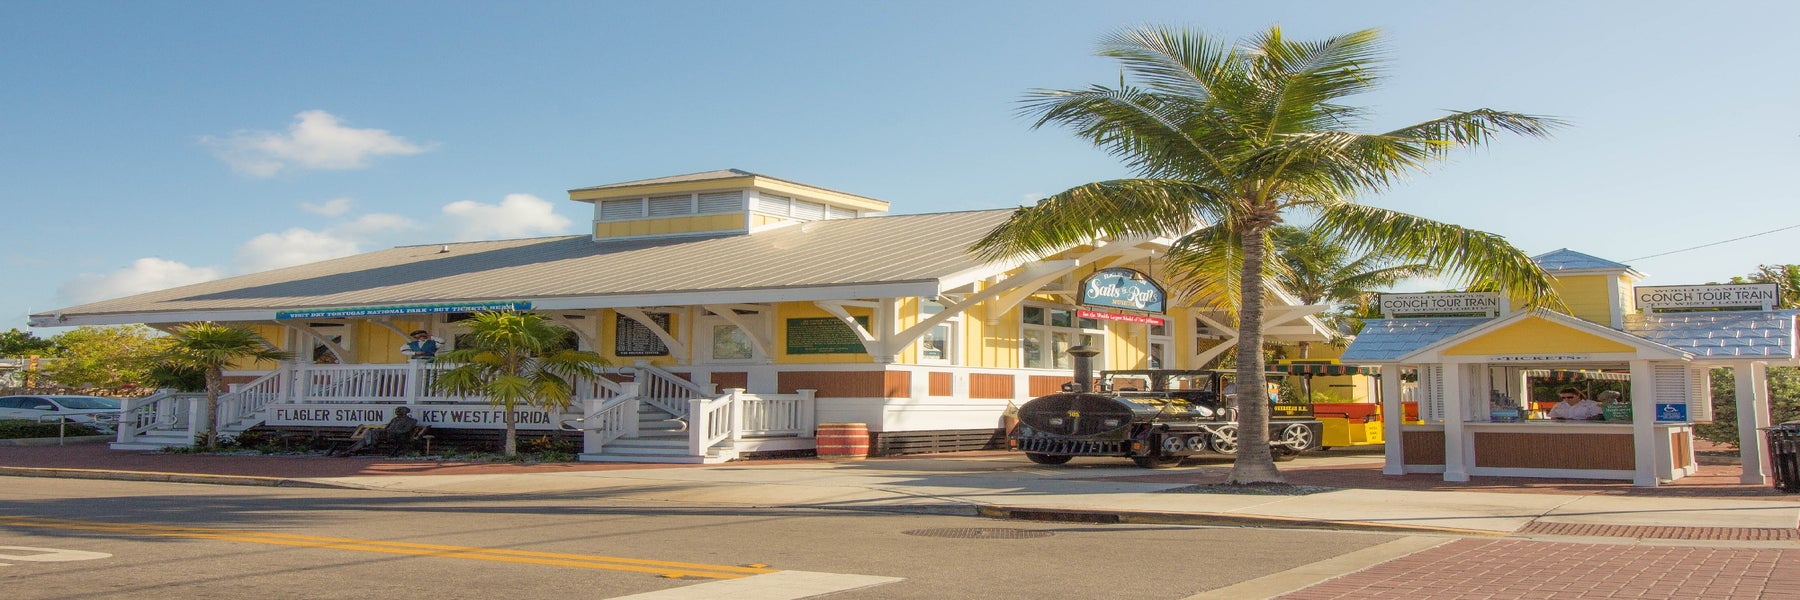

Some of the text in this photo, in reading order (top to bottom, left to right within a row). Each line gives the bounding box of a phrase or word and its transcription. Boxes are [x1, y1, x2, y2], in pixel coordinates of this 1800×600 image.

[1087, 278, 1120, 299] Sails
[1127, 285, 1158, 309] Rails
[1641, 290, 1773, 303] CONCH TOUR TRAIN
[1384, 297, 1496, 309] CONCH TOUR TRAIN
[277, 409, 383, 422] FLAGLER STATION
[423, 410, 448, 423] KEY
